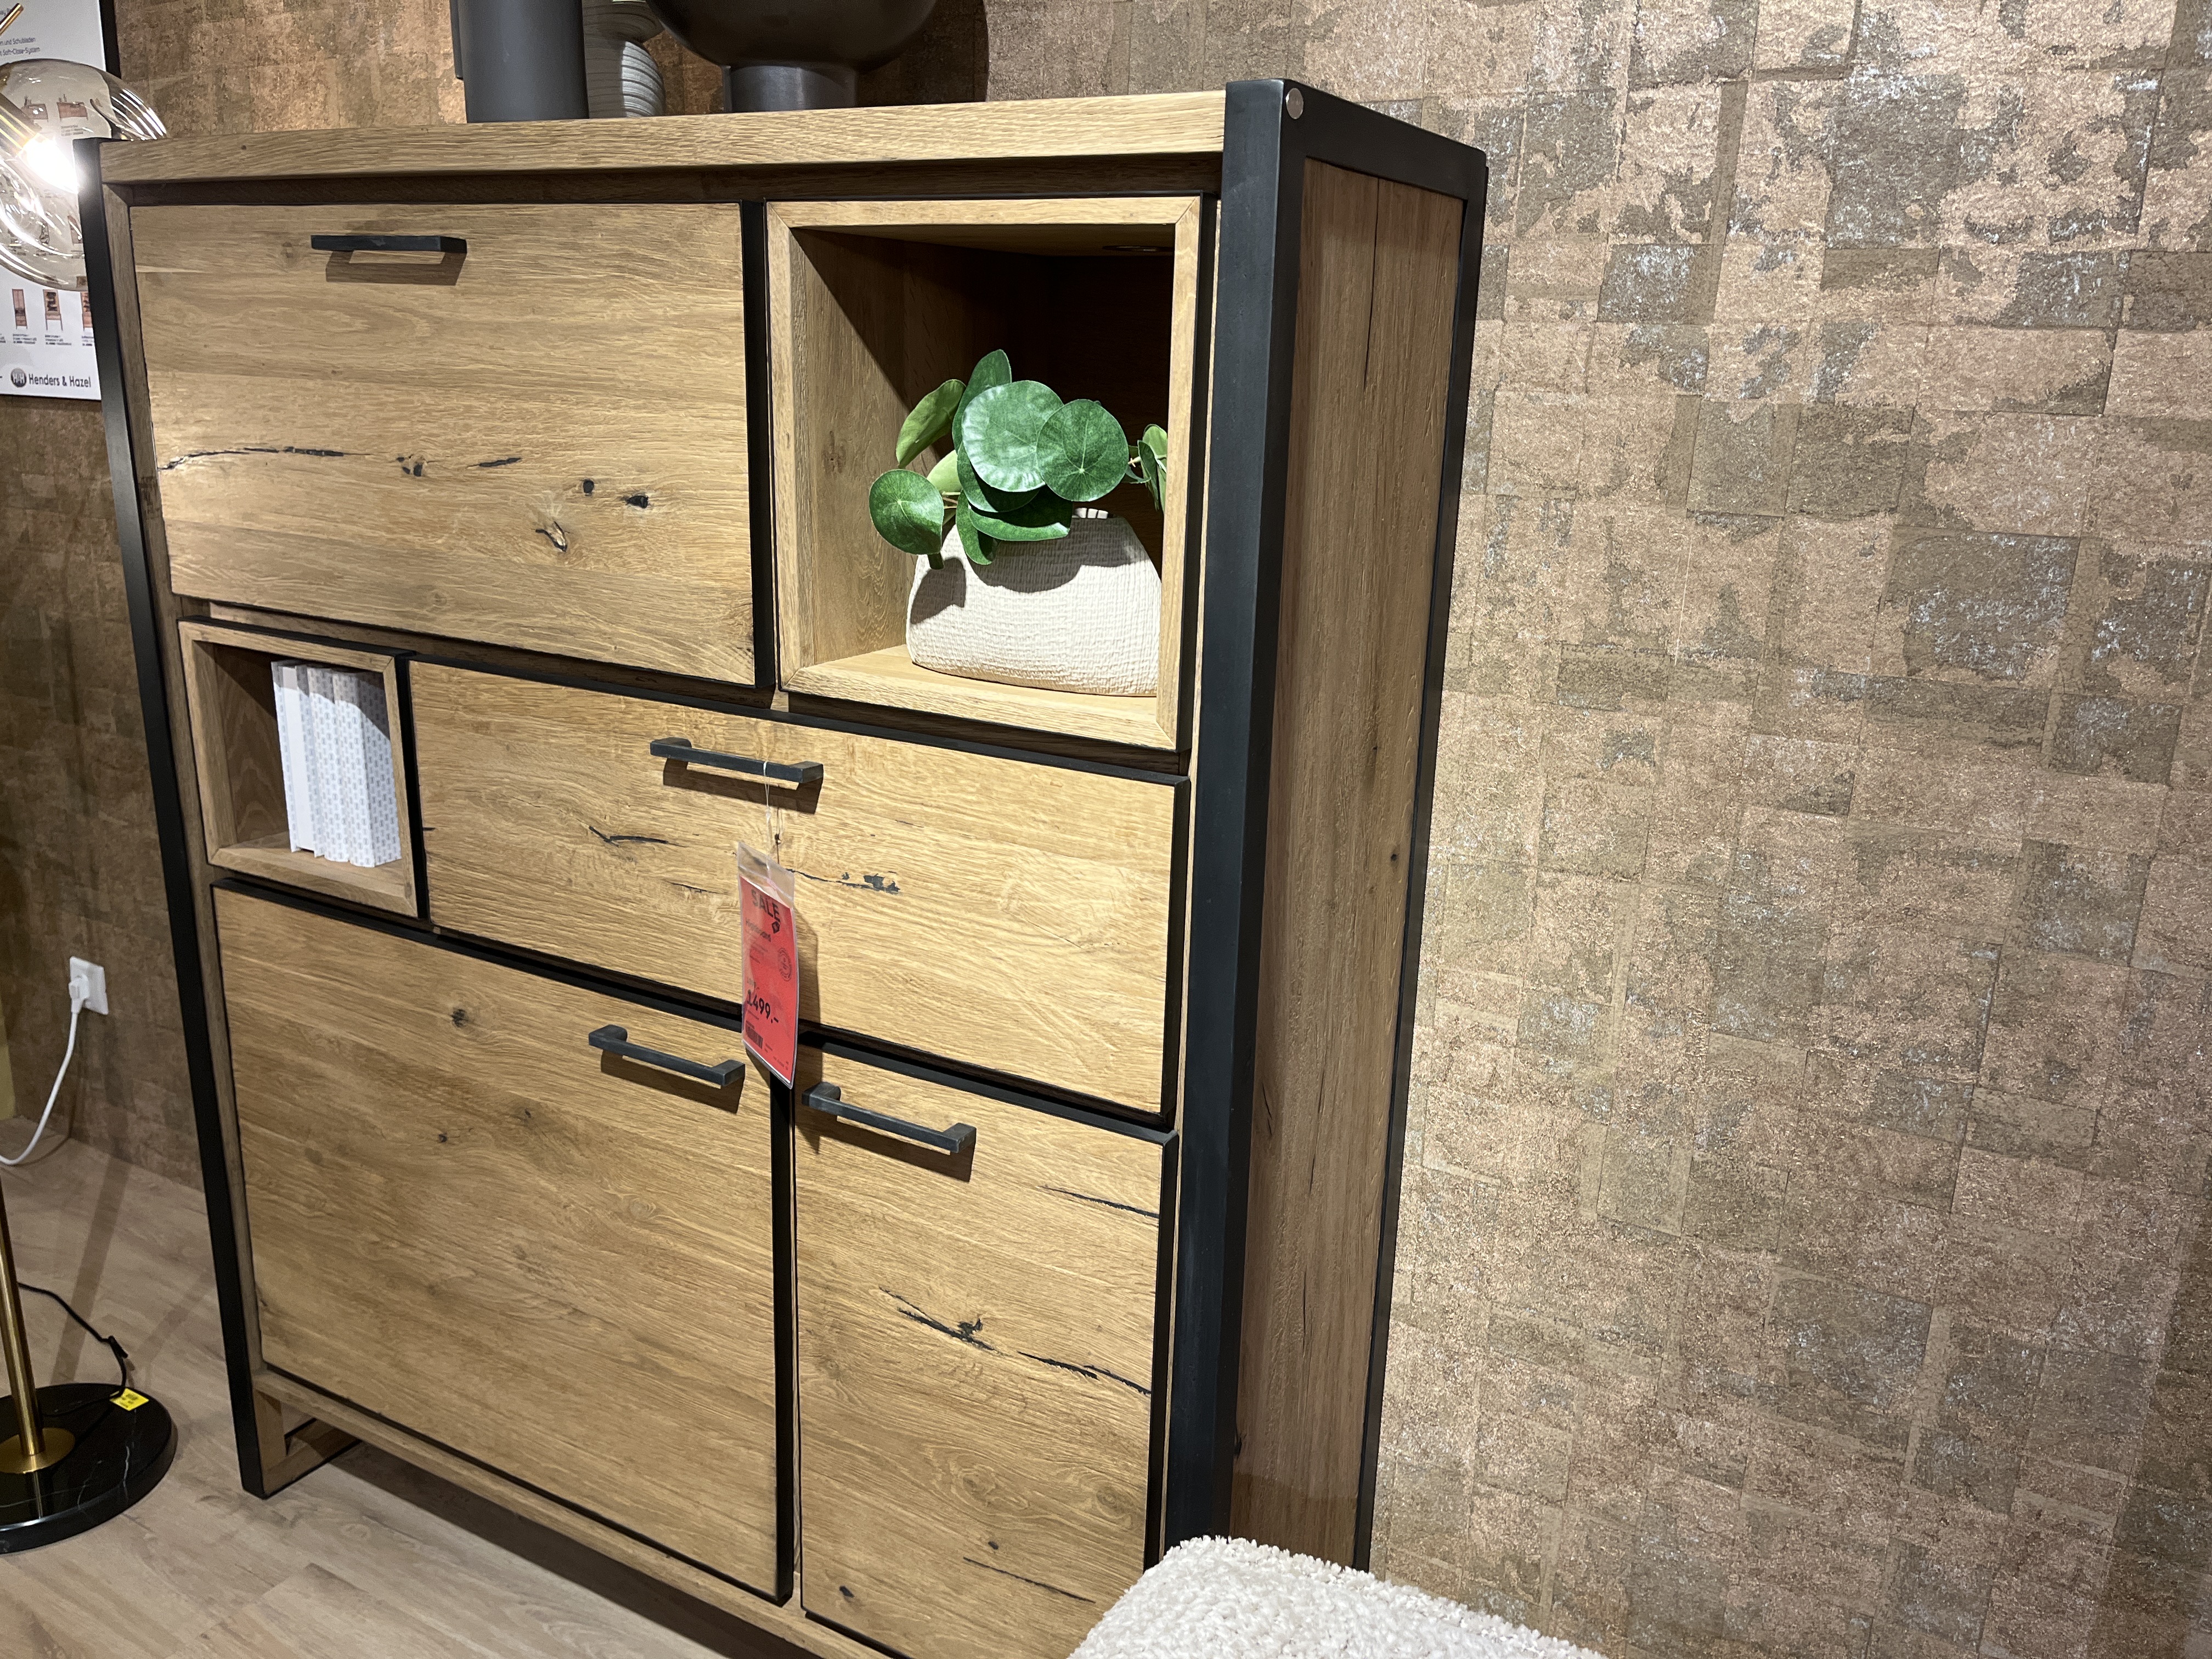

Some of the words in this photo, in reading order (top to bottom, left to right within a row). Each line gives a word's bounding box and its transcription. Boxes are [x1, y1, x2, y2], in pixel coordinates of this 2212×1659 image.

[29, 374, 60, 386] Henders
[62, 376, 67, 387] &
[69, 376, 92, 387] Hazel
[751, 889, 781, 922] SALE
